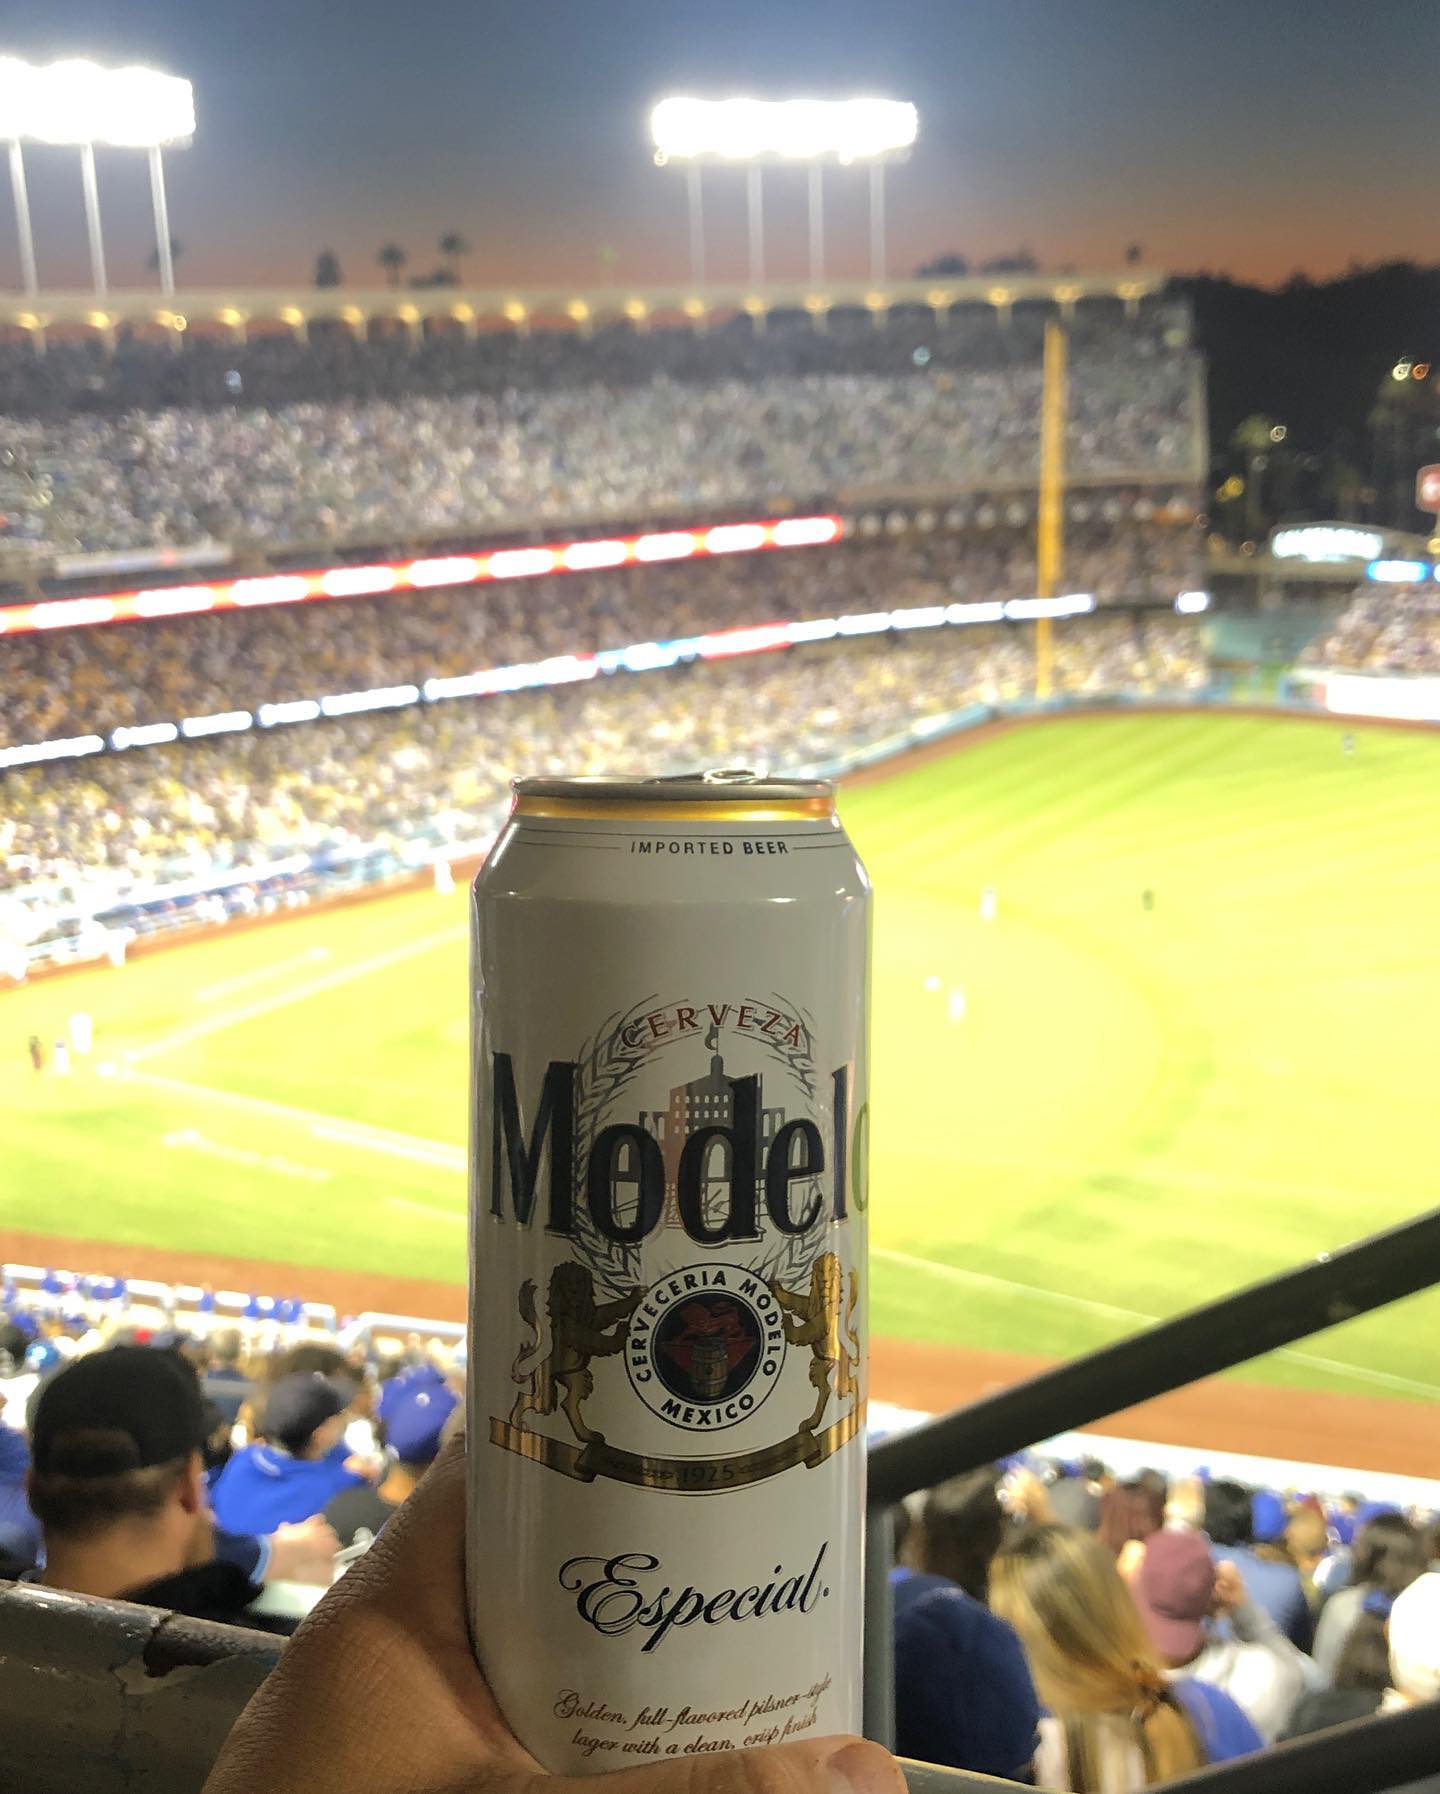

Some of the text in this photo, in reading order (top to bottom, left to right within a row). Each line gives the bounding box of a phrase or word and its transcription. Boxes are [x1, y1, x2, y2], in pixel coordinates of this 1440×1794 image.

[631, 840, 788, 855] IMPORTED BEER
[621, 1004, 800, 1048] CERVEZA
[631, 1270, 781, 1382] CERVECERIA MODELO
[661, 1394, 754, 1425] MEXICO
[681, 1463, 734, 1484] 1925
[571, 1727, 619, 1757] lager
[621, 1736, 660, 1754] with
[665, 1743, 678, 1754] a
